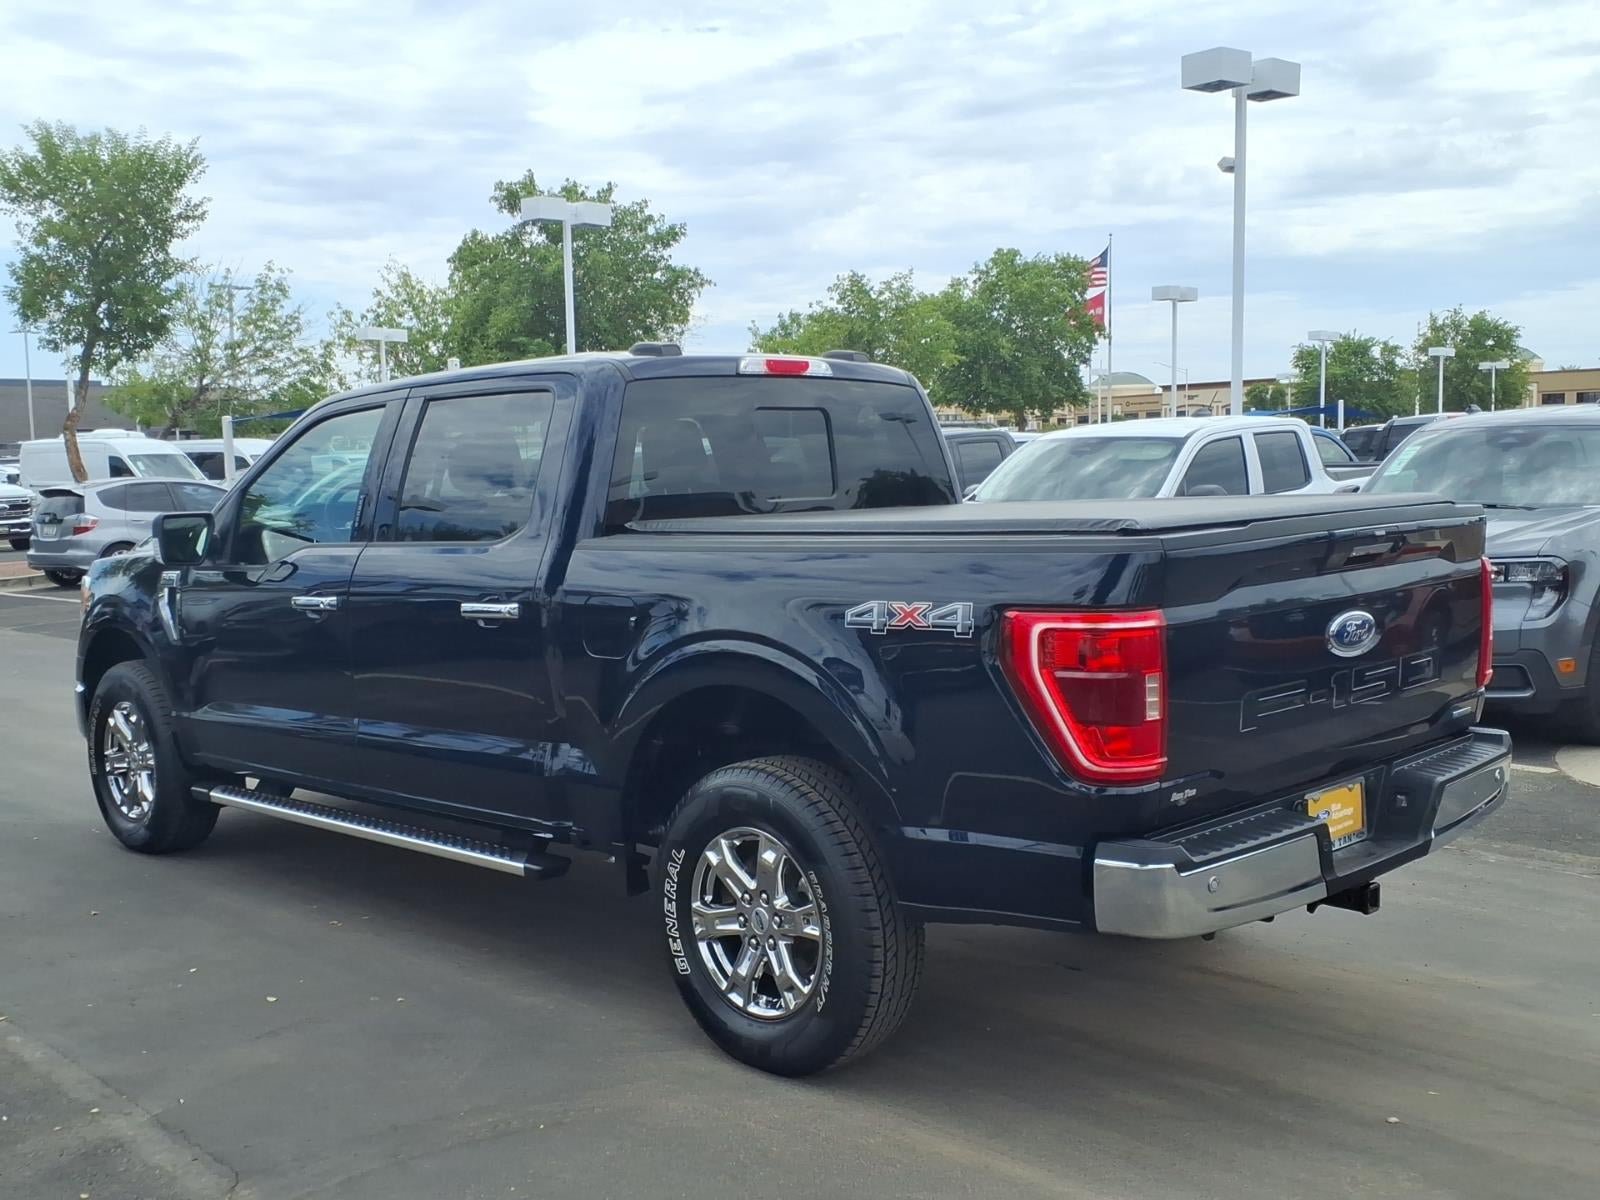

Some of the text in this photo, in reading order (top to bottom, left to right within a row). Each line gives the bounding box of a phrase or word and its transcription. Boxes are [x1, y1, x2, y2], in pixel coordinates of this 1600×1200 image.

[1343, 620, 1369, 643] Ford
[1239, 648, 1442, 732] F-150
[664, 848, 691, 975] GENERAL
